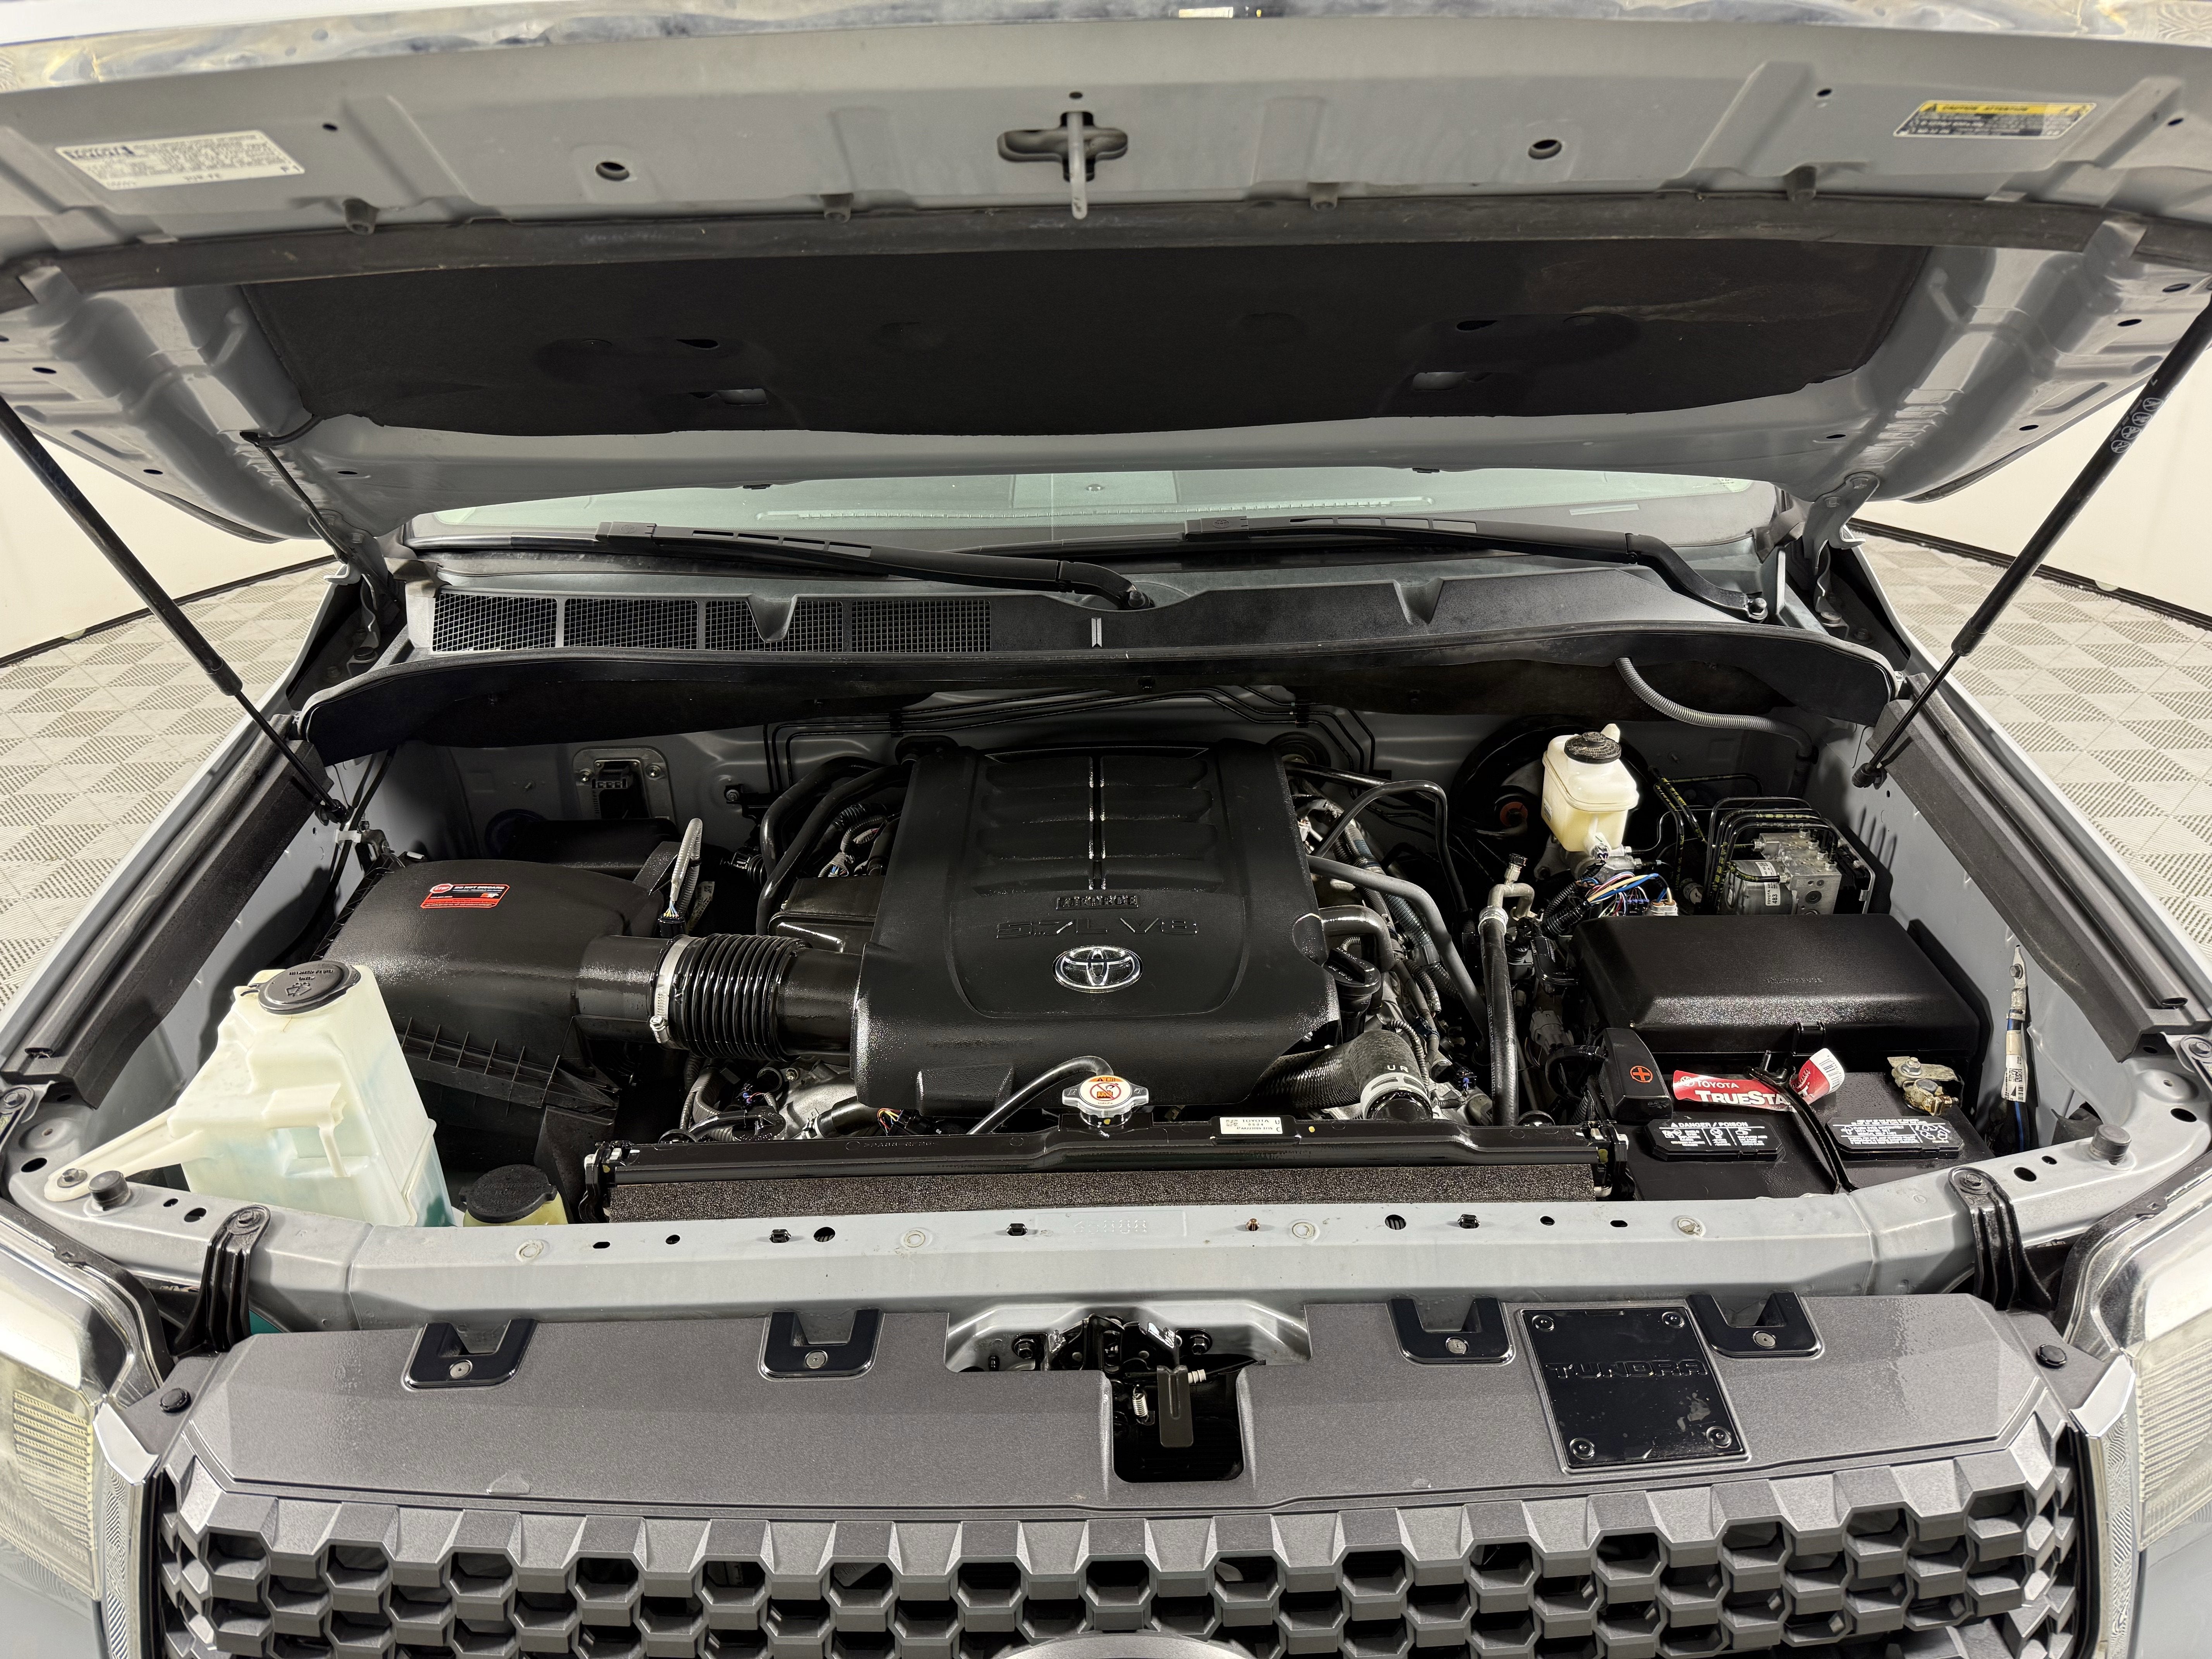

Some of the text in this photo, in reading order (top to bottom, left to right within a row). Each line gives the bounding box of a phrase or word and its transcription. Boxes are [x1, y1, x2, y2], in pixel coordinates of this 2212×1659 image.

[1120, 917, 1198, 934] V8
[1696, 1080, 1740, 1089] TOYOTA
[1545, 1359, 1708, 1379] TUNDRA
